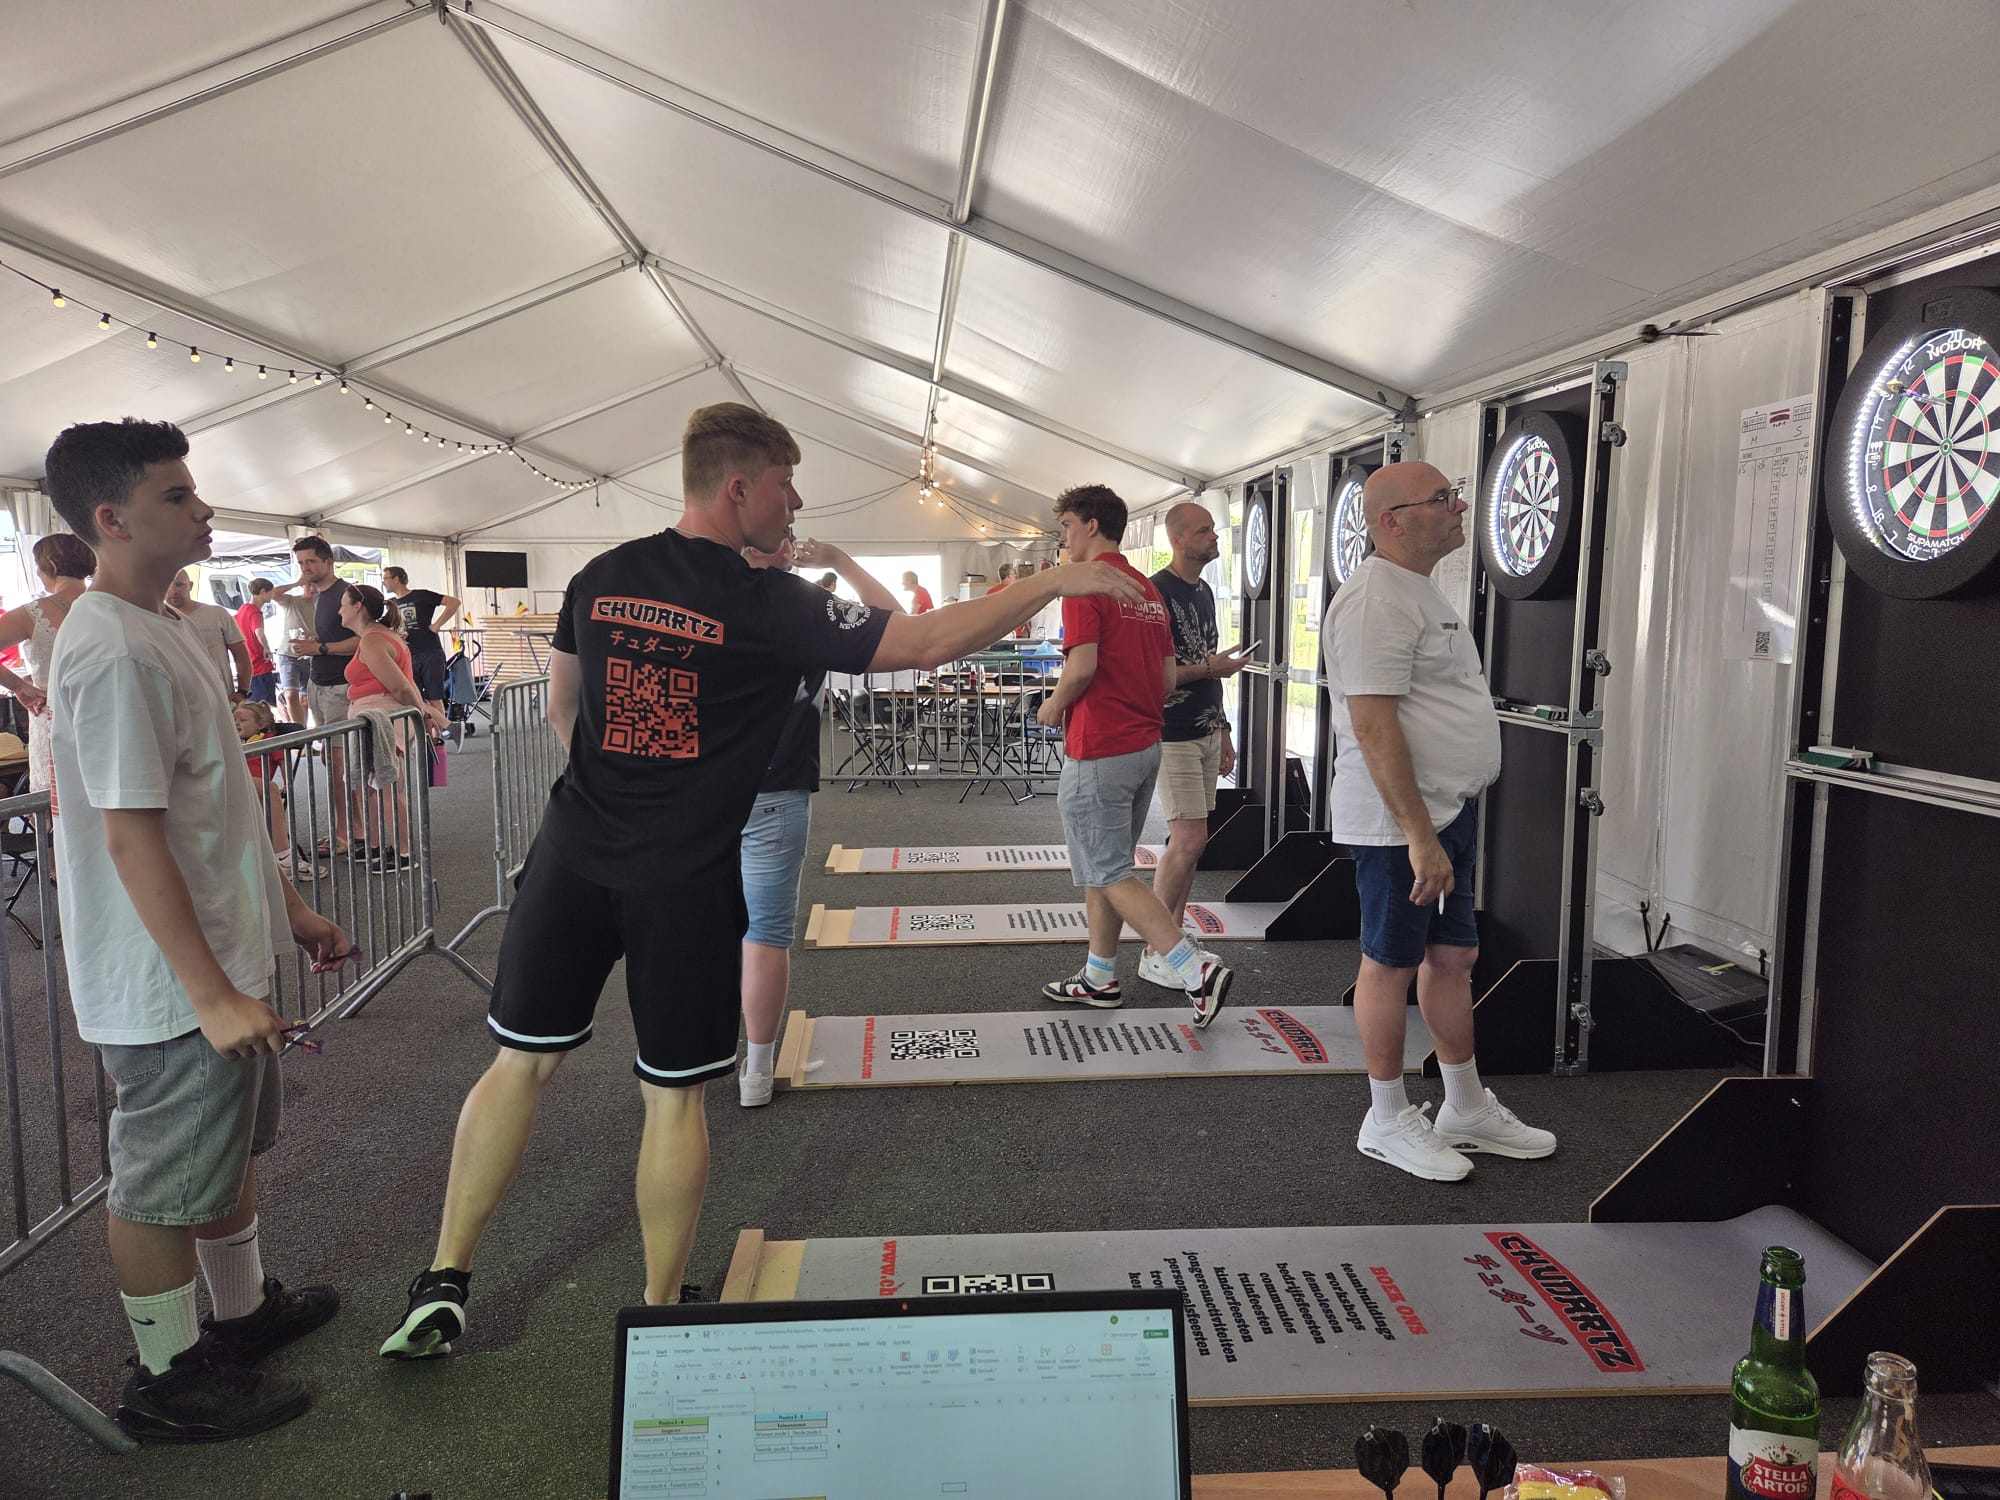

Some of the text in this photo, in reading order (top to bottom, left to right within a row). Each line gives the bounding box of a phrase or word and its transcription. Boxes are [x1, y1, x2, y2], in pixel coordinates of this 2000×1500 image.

[1907, 532, 1964, 548] SUPAMATCH
[596, 600, 722, 640] CHUDARTZ
[1182, 1251, 1238, 1363] jongerenactiviteiten
[1213, 1266, 1254, 1343] kinderfeesten
[1238, 1272, 1274, 1335] tuinfeesten
[1259, 1271, 1298, 1334] communies
[1276, 1262, 1326, 1344] bedrijfsfeesten
[1302, 1270, 1344, 1334] demolessen
[1324, 1271, 1366, 1332] workshops
[1340, 1262, 1396, 1341] teambuildings
[1499, 1235, 1636, 1368] CHUDARTZ
[1752, 1475, 1808, 1494] ARTOIS
[1754, 1463, 1808, 1482] STELLA
